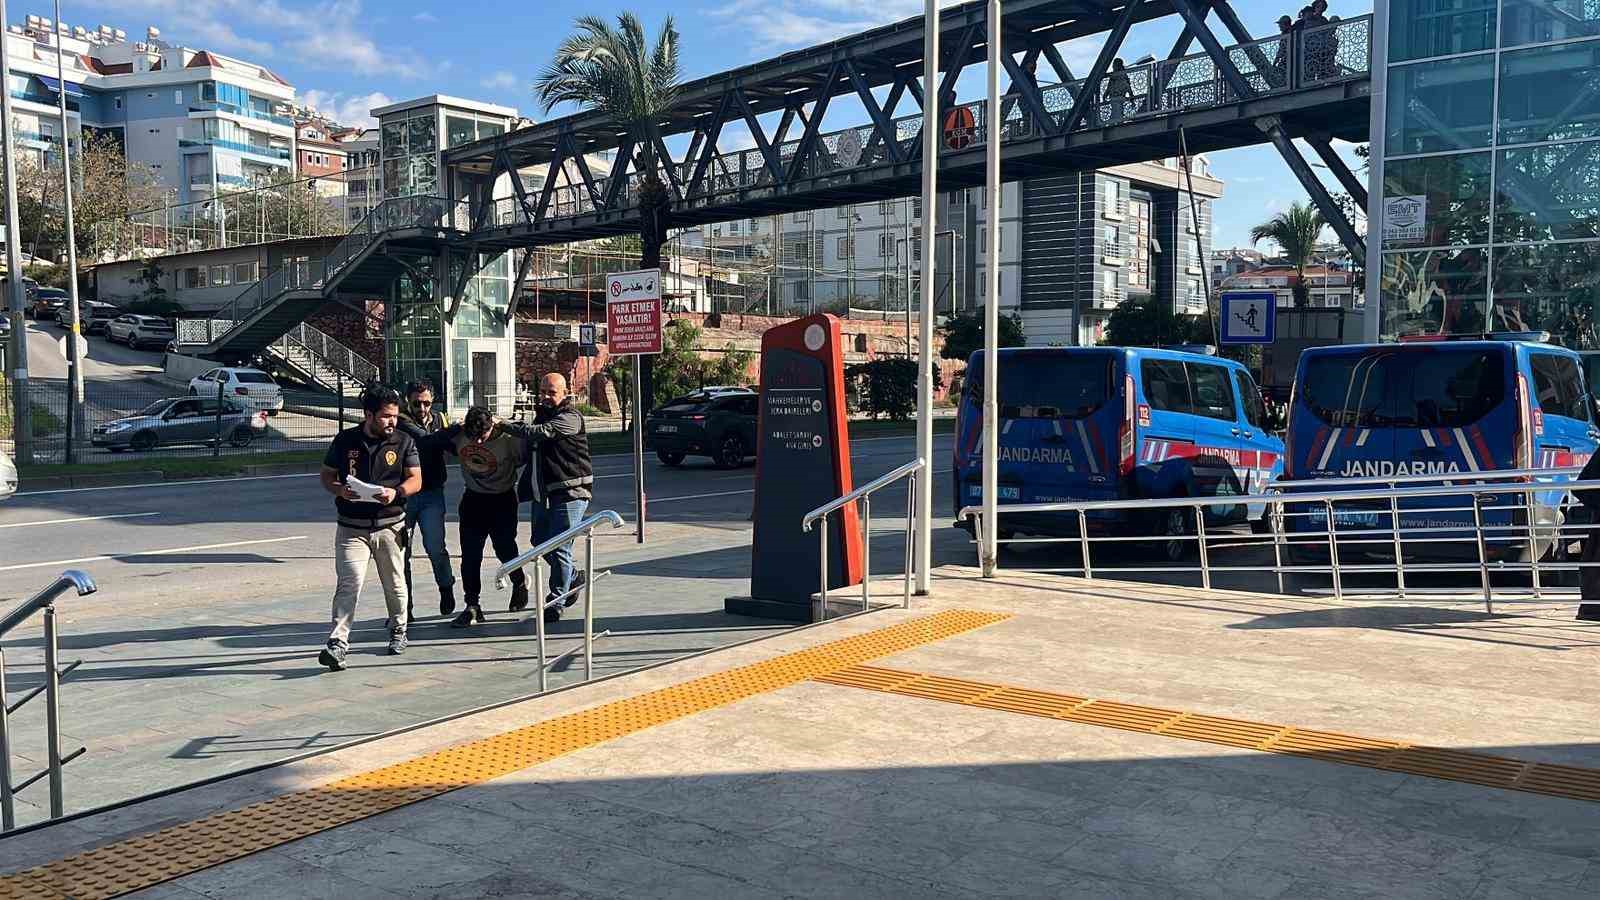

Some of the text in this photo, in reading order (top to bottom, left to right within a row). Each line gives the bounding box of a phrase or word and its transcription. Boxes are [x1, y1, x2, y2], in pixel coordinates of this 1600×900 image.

[612, 301, 655, 314] PARK ETMEK
[996, 447, 1073, 464] JANDARMA
[1200, 447, 1241, 466] JANDARMA
[1340, 460, 1461, 477] JANDARMA
